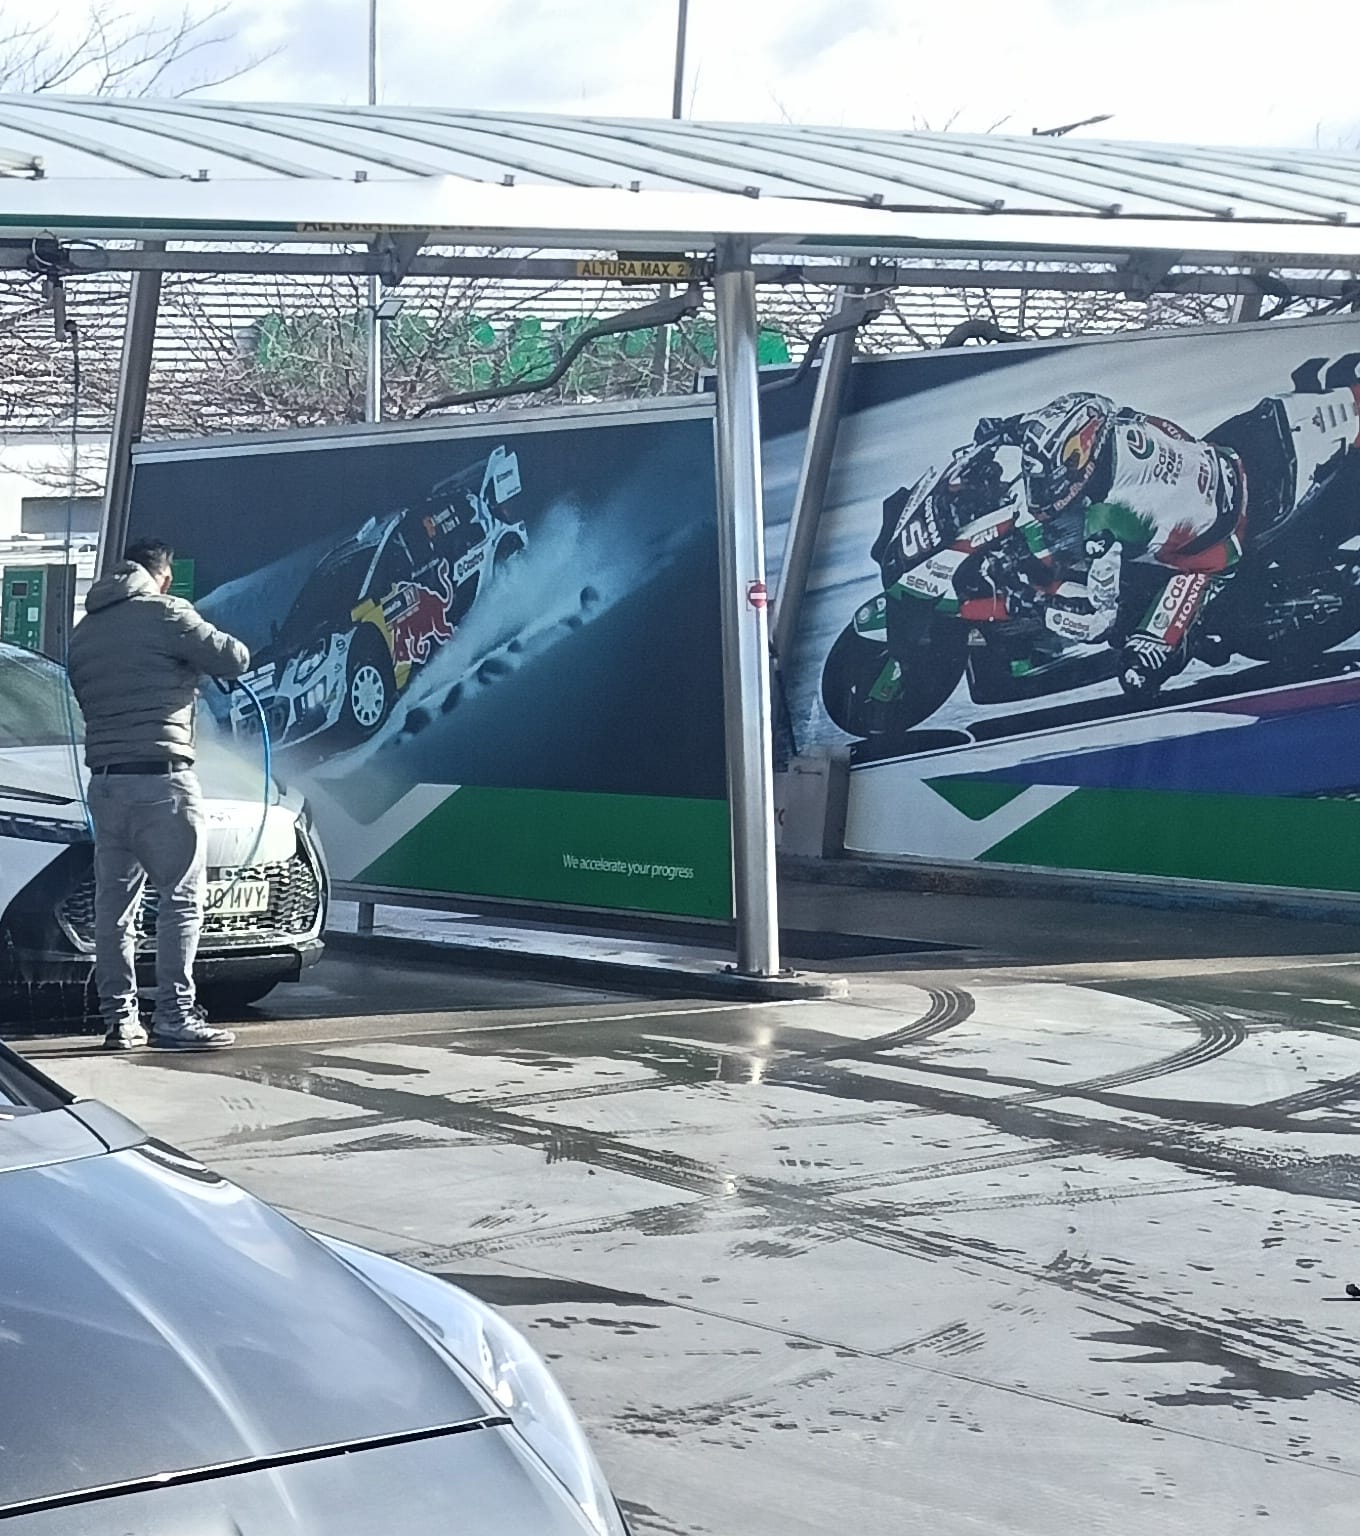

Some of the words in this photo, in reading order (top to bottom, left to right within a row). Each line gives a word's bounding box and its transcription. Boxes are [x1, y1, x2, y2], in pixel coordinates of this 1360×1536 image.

[582, 262, 637, 277] ALTURA
[906, 575, 939, 595] SENA
[562, 853, 579, 869] We
[580, 858, 627, 873] accelerate
[627, 864, 650, 877] your
[651, 865, 694, 880] progress
